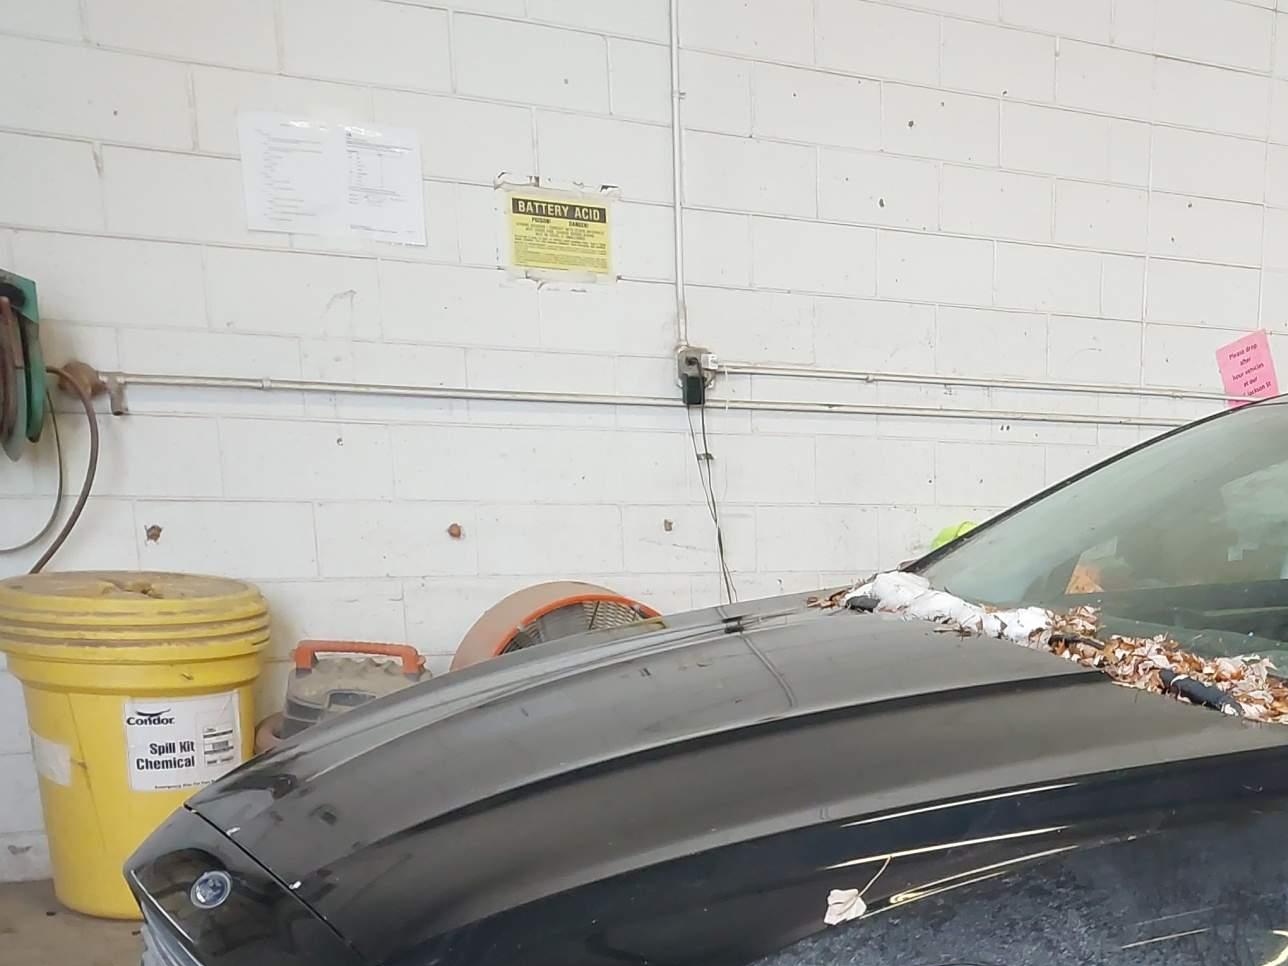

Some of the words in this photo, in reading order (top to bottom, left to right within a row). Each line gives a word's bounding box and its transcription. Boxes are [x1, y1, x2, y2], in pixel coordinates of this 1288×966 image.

[518, 200, 569, 217] BATTERY
[575, 208, 600, 220] ACID
[126, 716, 175, 726] Condor
[149, 742, 176, 756] Spill
[179, 741, 195, 752] Kit
[136, 756, 195, 770] Chemical
